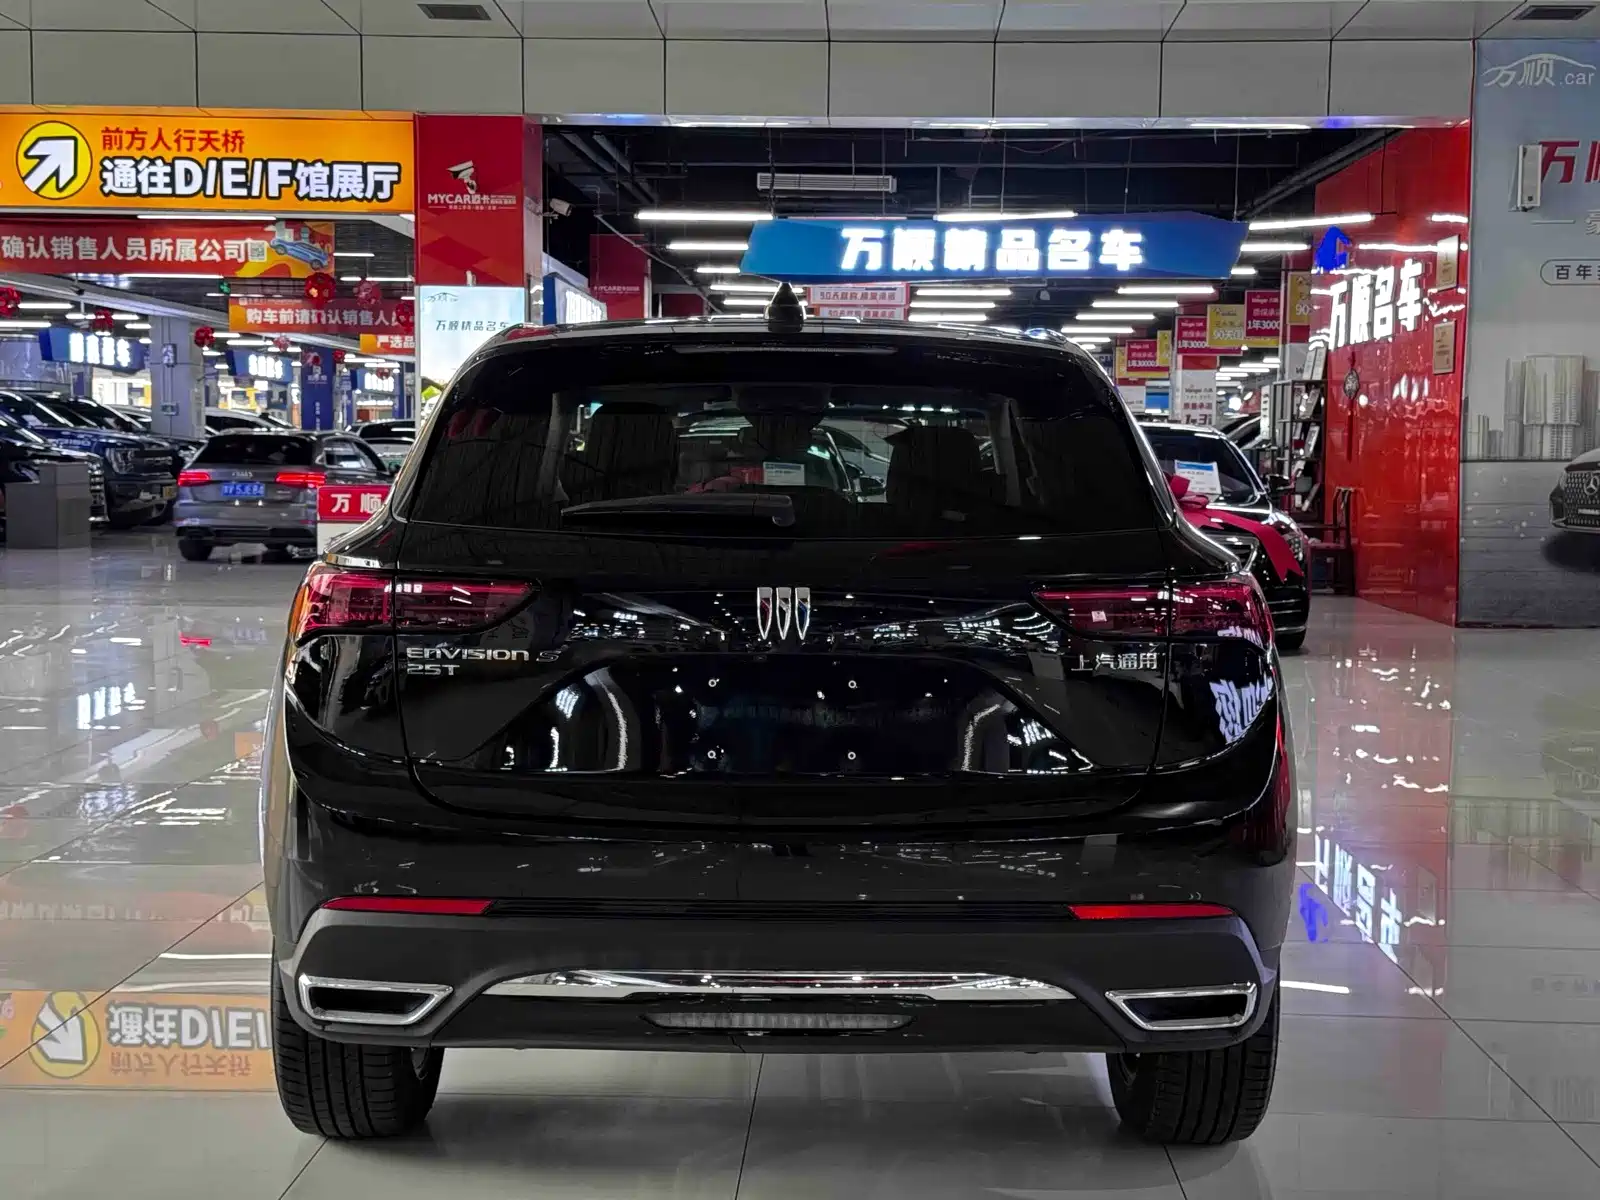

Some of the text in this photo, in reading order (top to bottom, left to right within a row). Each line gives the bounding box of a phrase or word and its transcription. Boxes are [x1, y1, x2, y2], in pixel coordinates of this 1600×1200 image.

[101, 127, 245, 153] 前方人行天桥
[101, 157, 400, 201] 通往D/E/F馆展厅
[0, 235, 249, 264] 确认销售人员所属公司
[1555, 264, 1600, 280] 百年
[406, 647, 562, 662] ENVISION S
[1071, 652, 1158, 670] 上汽通用
[406, 664, 460, 676] 25T
